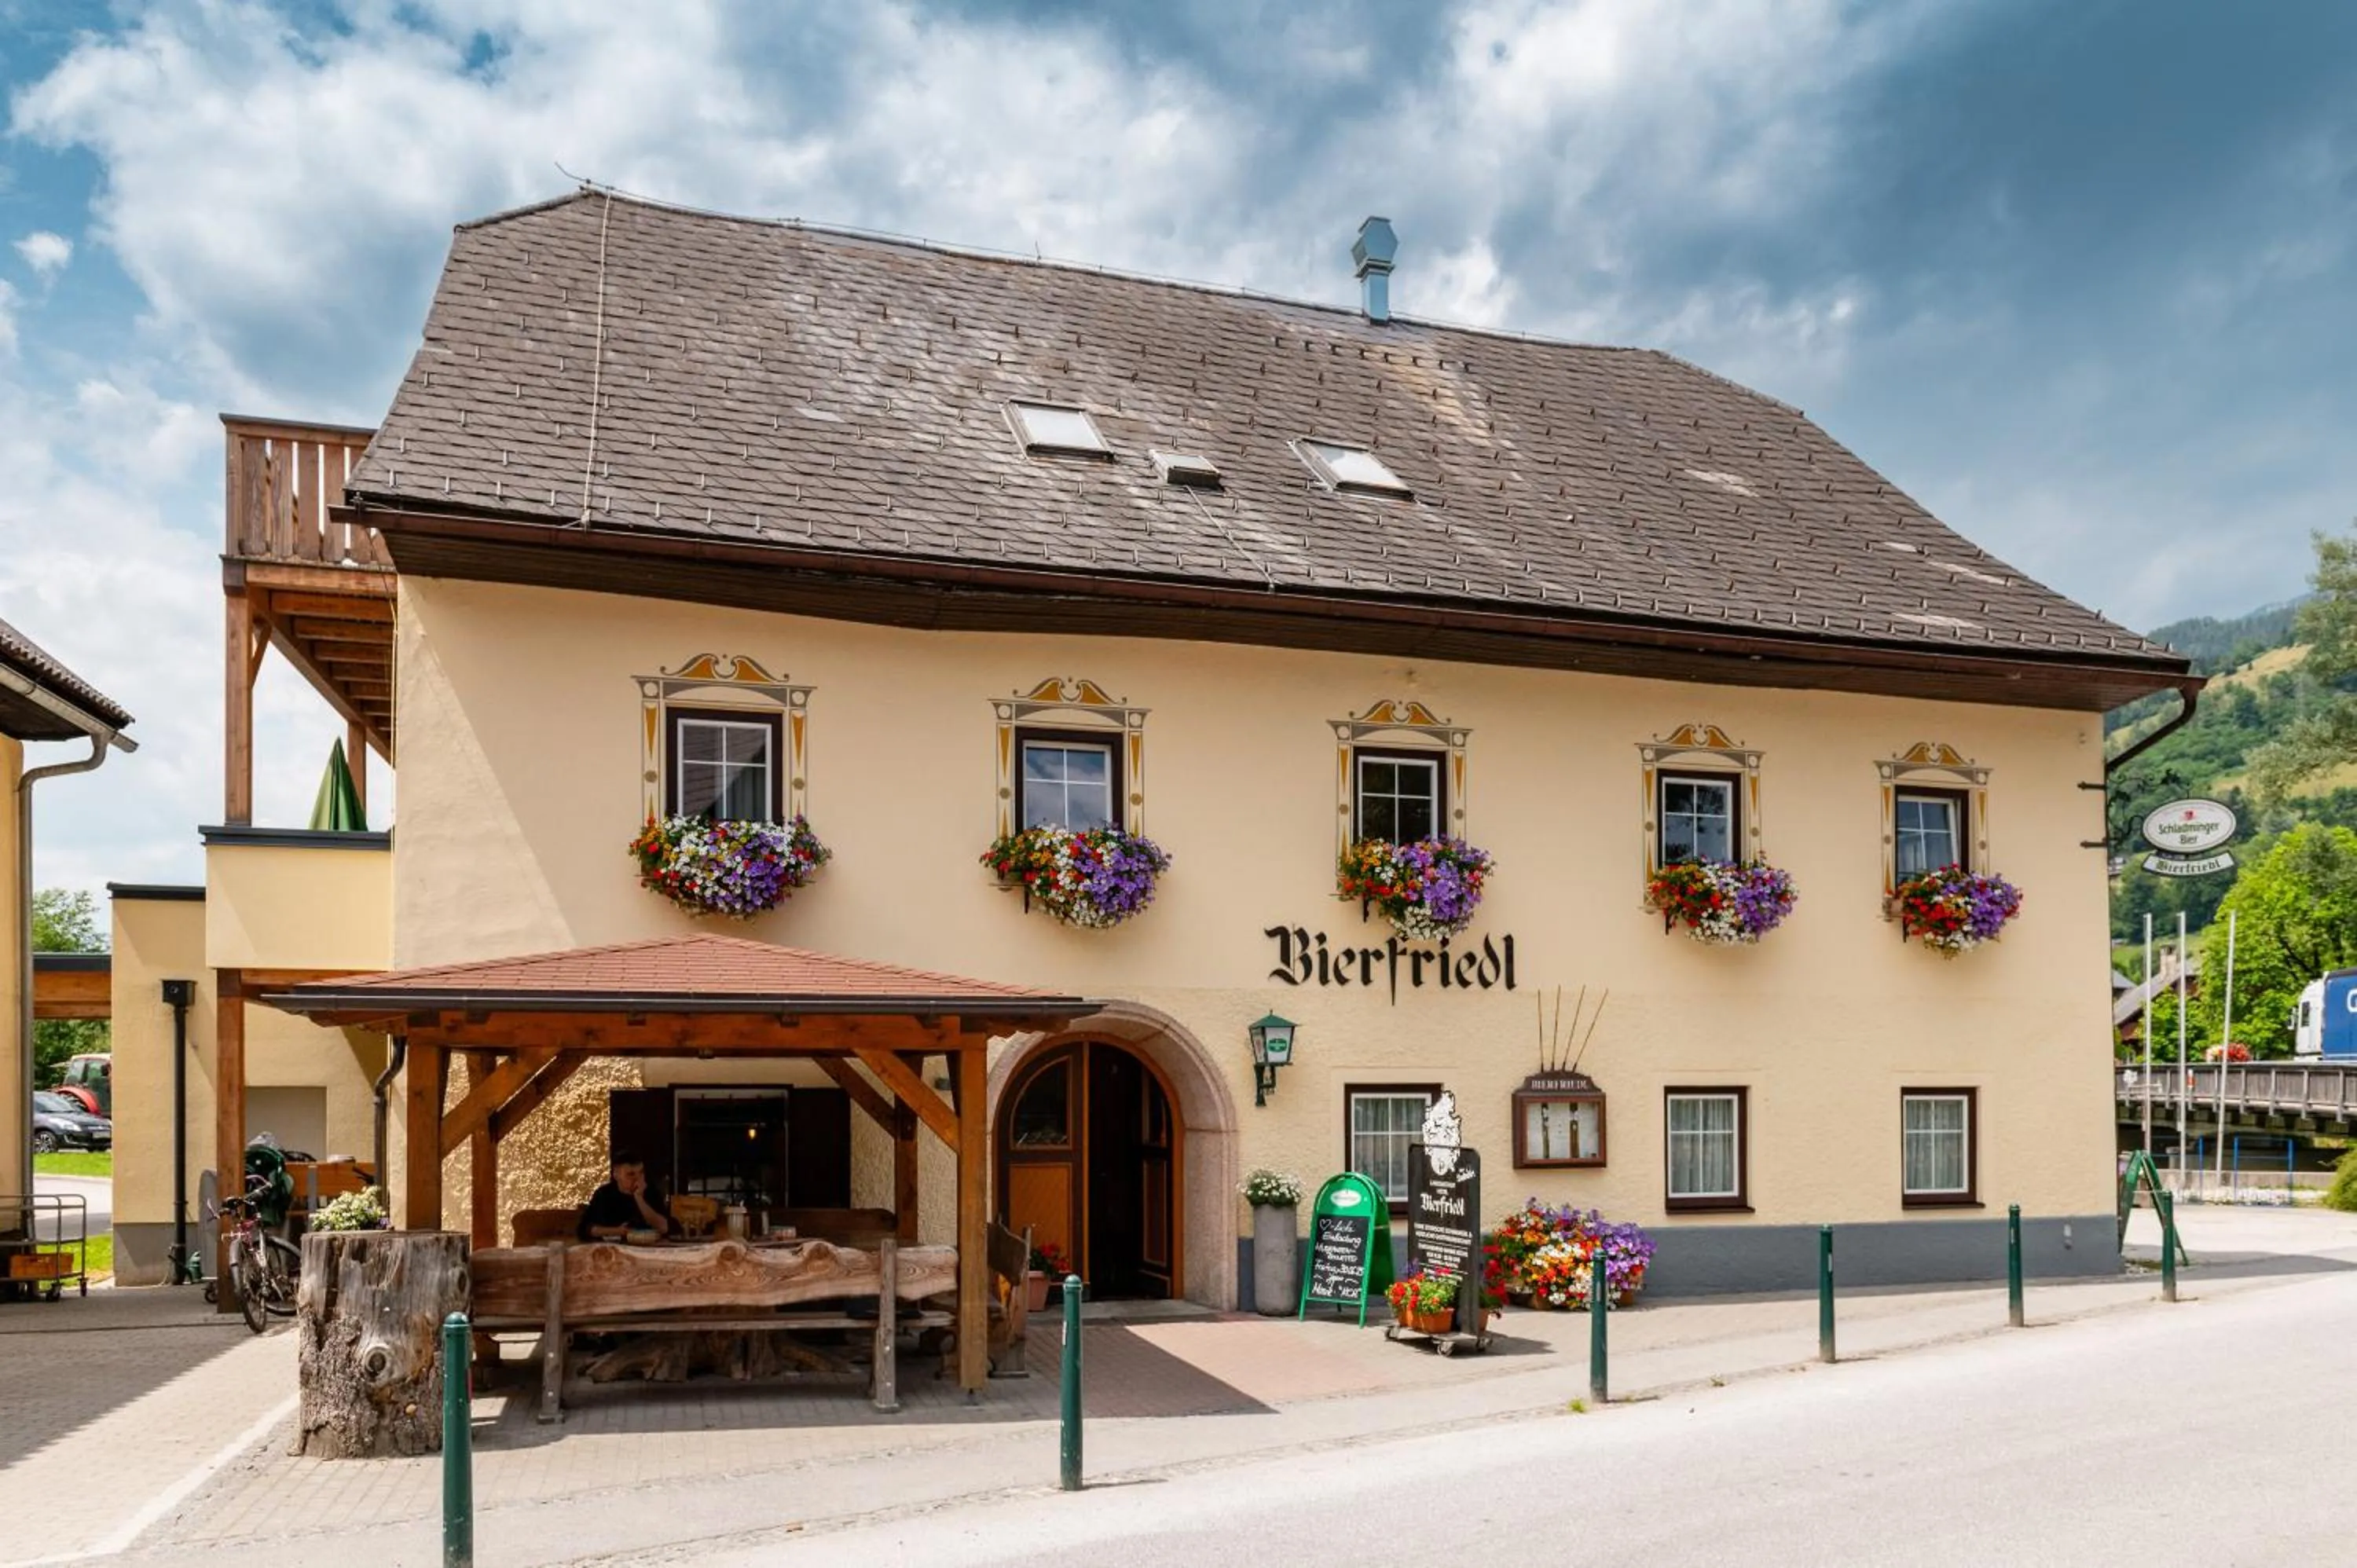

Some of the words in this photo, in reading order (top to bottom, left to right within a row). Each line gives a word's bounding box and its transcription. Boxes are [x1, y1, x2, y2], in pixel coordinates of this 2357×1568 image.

[2157, 822, 2219, 835] Schladminger
[2179, 835, 2198, 844] Bier
[2157, 859, 2220, 874] Bierfriedl
[1263, 924, 1517, 1006] Bierfriedl
[1420, 1192, 1465, 1218] Bierfriedl
